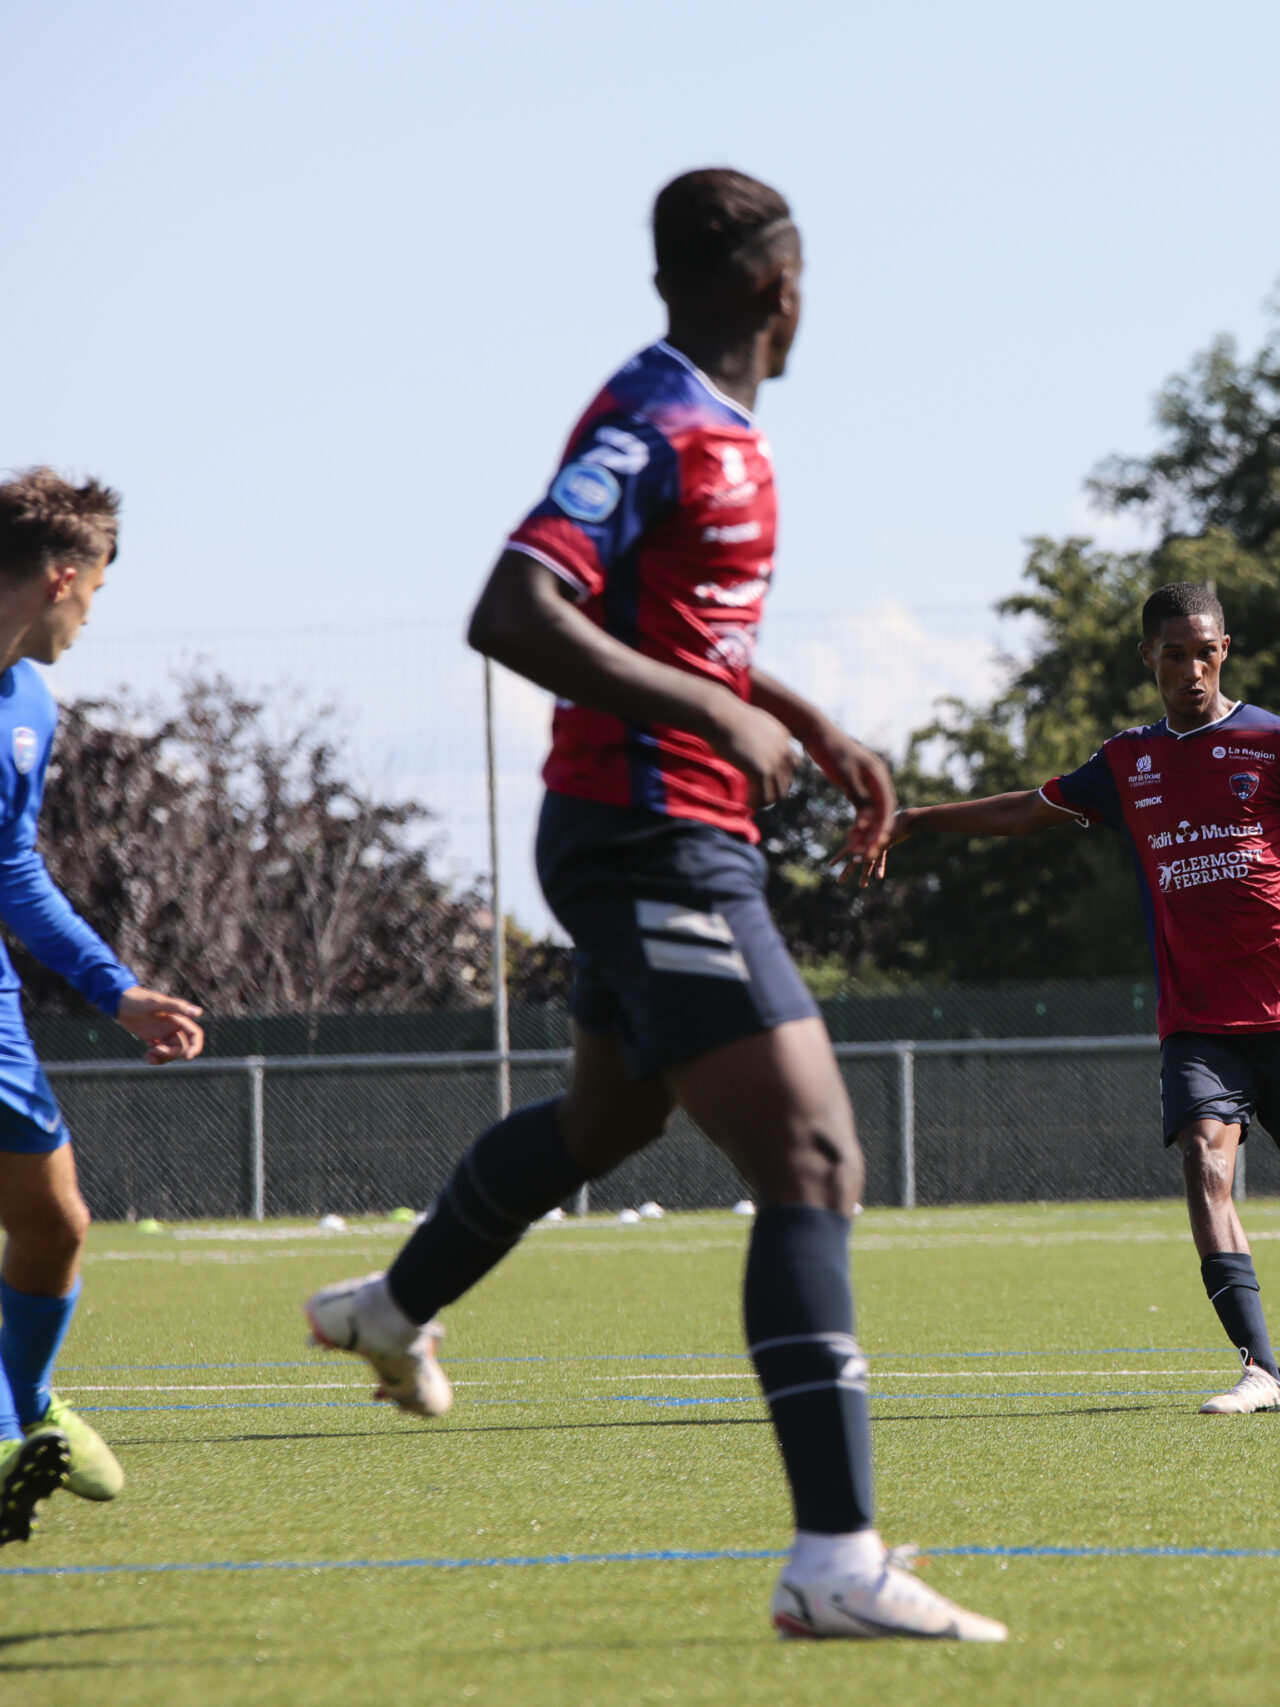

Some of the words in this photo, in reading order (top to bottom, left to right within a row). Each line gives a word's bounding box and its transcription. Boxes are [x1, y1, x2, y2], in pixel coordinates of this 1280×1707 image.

[1228, 746, 1240, 754] La
[1242, 748, 1275, 760] Région
[1201, 821, 1263, 840] Mutuel
[1171, 849, 1262, 875] CLERMONT
[1173, 864, 1249, 890] FERRAND
